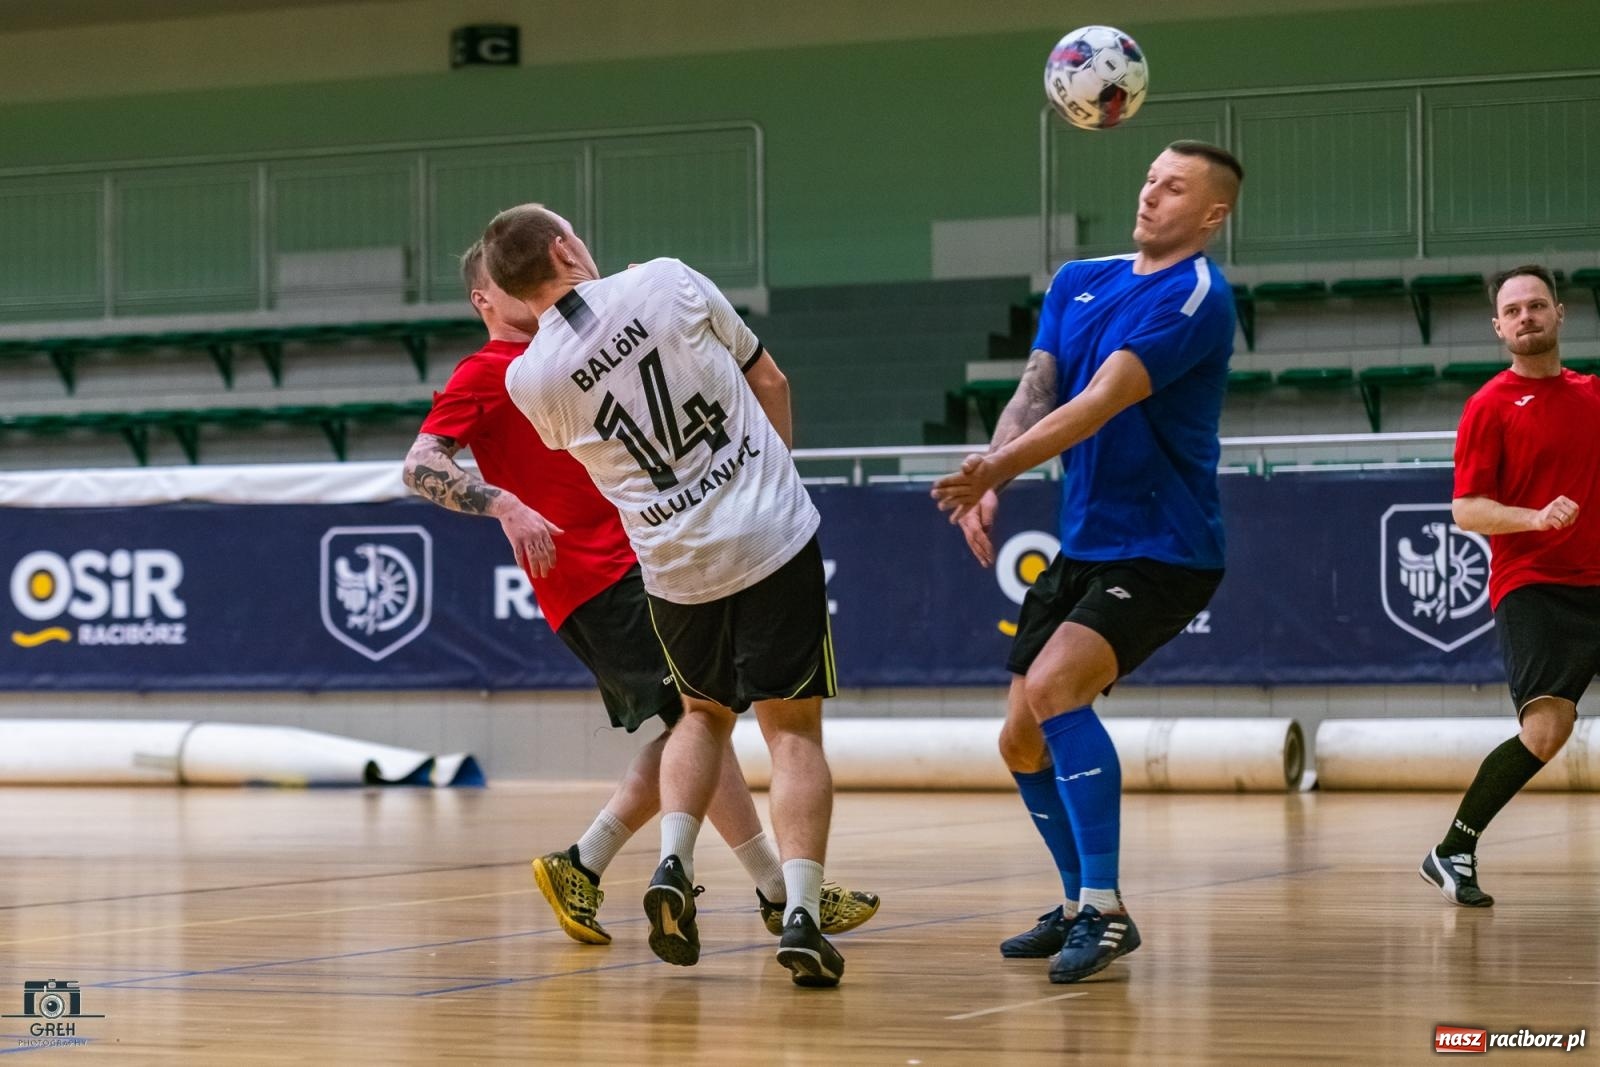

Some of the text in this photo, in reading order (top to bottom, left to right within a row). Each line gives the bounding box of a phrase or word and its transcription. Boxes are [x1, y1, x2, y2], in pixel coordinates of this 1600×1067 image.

[478, 38, 511, 61] C
[1053, 77, 1093, 120] SELECT
[593, 346, 731, 493] 14
[78, 618, 187, 645] RACIBÓRZ
